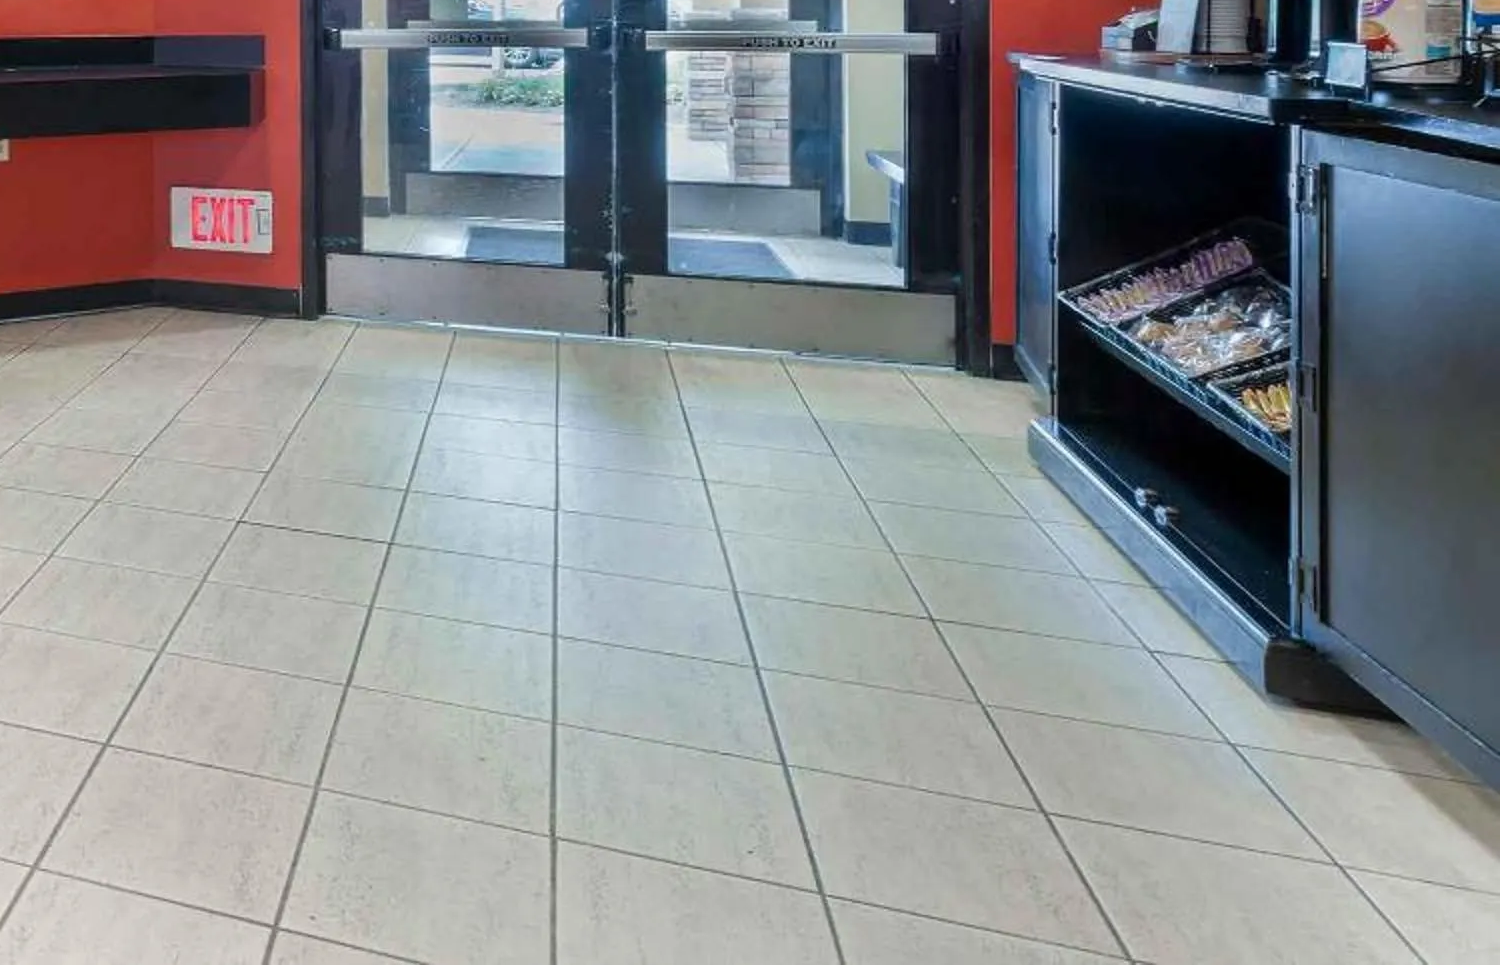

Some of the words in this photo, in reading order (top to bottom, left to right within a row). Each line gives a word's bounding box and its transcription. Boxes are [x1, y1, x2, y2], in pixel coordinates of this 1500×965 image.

[782, 36, 800, 47] TO
[804, 36, 835, 48] EXIT
[191, 196, 255, 244] EXIT
